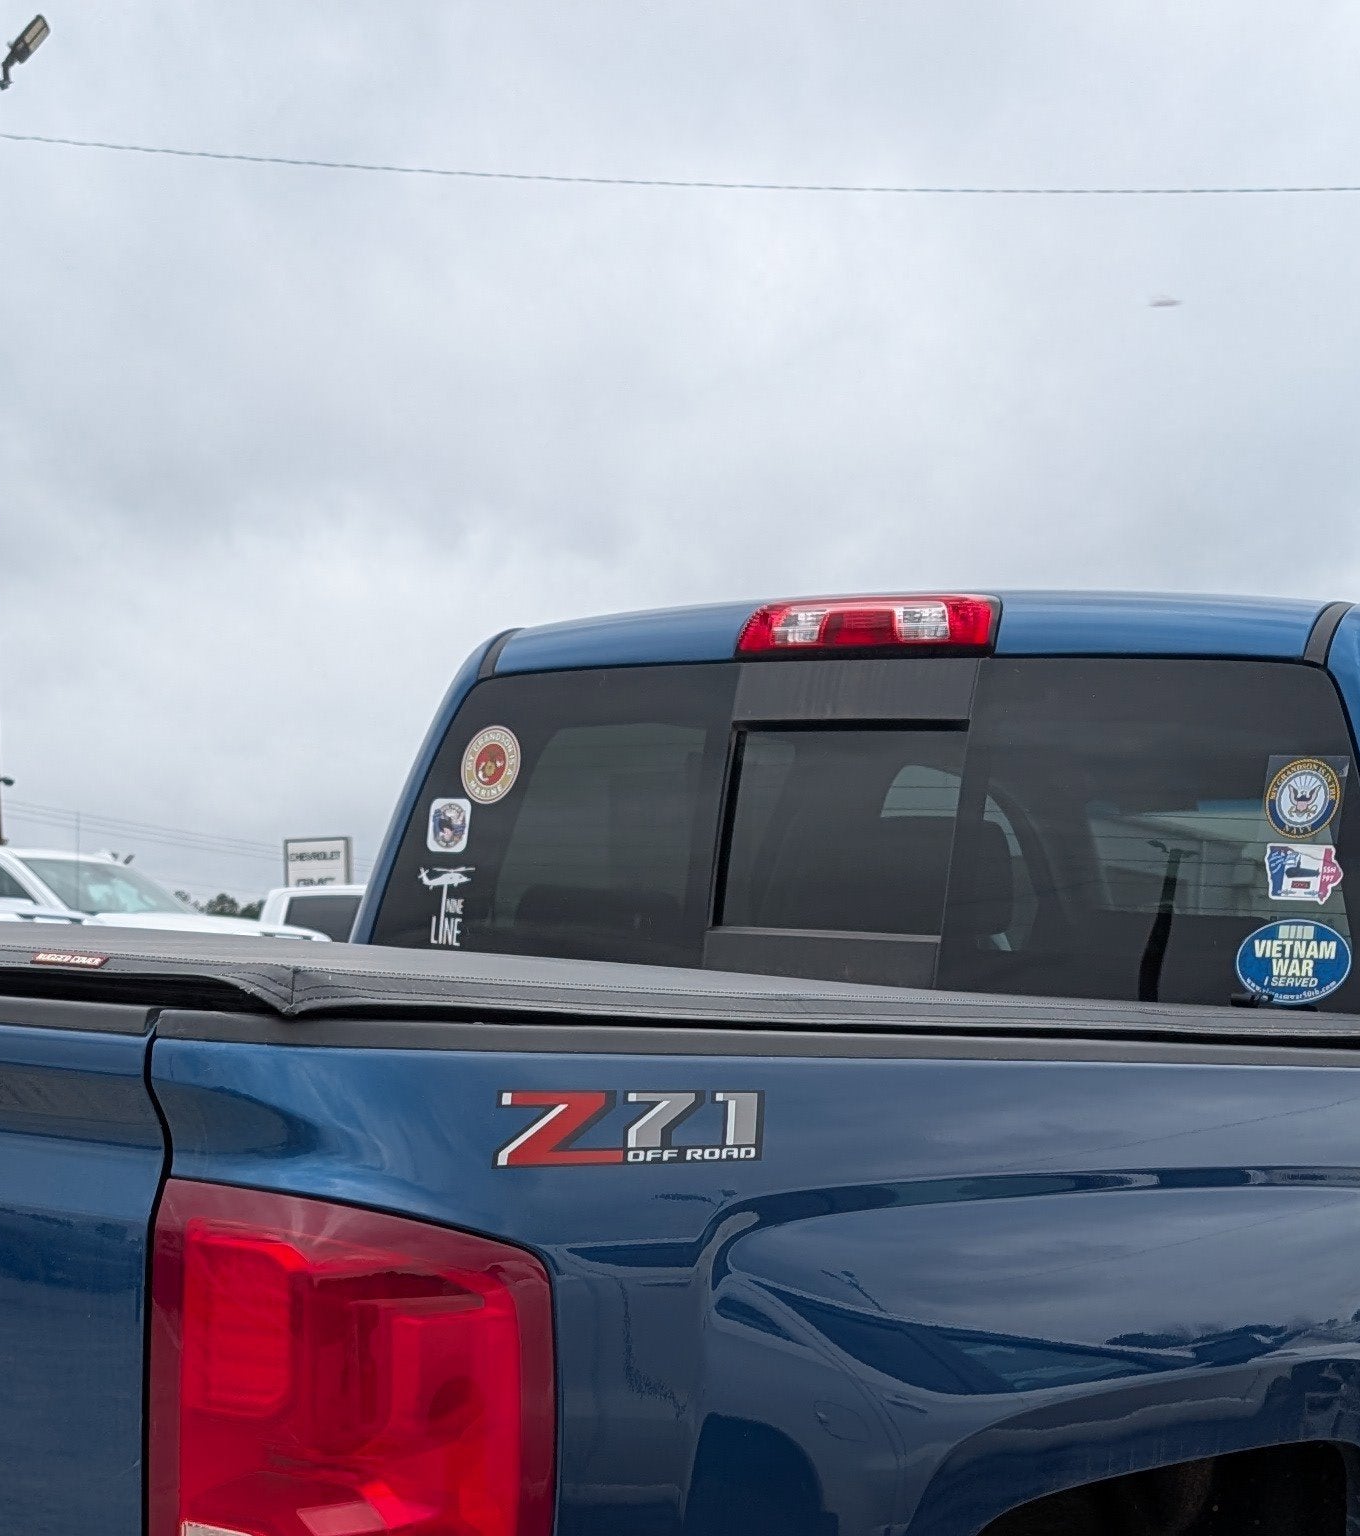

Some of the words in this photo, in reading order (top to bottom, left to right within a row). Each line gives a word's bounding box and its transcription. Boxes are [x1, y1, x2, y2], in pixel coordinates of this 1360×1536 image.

[469, 779, 503, 798] MARINE
[1283, 824, 1313, 835] NAVY
[289, 851, 341, 862] CHEVROLET
[430, 915, 463, 946] LINE
[1254, 939, 1338, 960] VIETNAM
[1272, 959, 1315, 977] WAR
[1264, 975, 1270, 986] I
[1271, 977, 1319, 988] SERVED
[492, 1090, 765, 1169] Z71
[627, 1149, 679, 1163] OFF
[685, 1147, 757, 1162] ROAD
